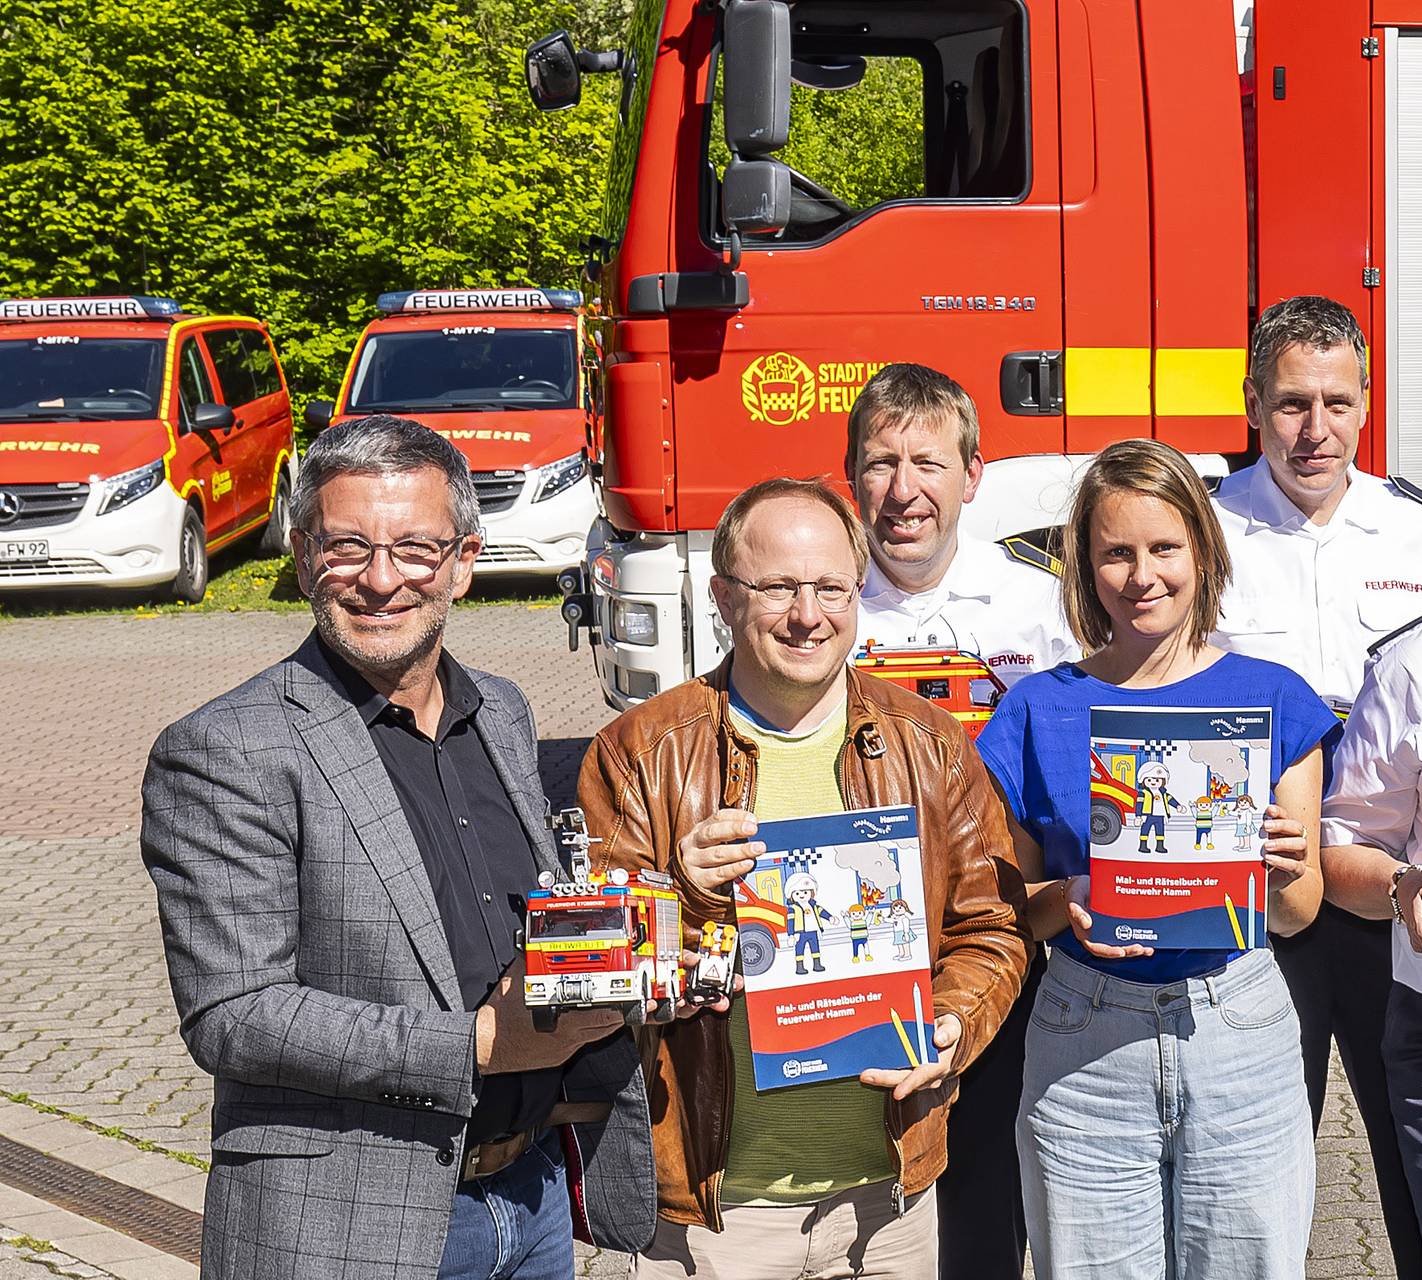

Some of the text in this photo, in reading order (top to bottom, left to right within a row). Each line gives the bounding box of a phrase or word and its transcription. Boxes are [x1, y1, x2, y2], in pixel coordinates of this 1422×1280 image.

[413, 293, 543, 308] FEUERWEHR
[921, 296, 1036, 311] TGM 18.340
[3, 303, 138, 317] FEUERWEHR
[442, 327, 496, 335] 1-MTF-2
[818, 362, 864, 384] STADT
[7, 543, 47, 556] FW 92
[1115, 875, 1218, 886] Mal- und Rätselbuch der
[1115, 886, 1191, 896] Feuerwehr Hamm
[776, 992, 882, 1014] Mal- und Rätselbuch der
[777, 1008, 855, 1026] Feuerwehr Hamm
